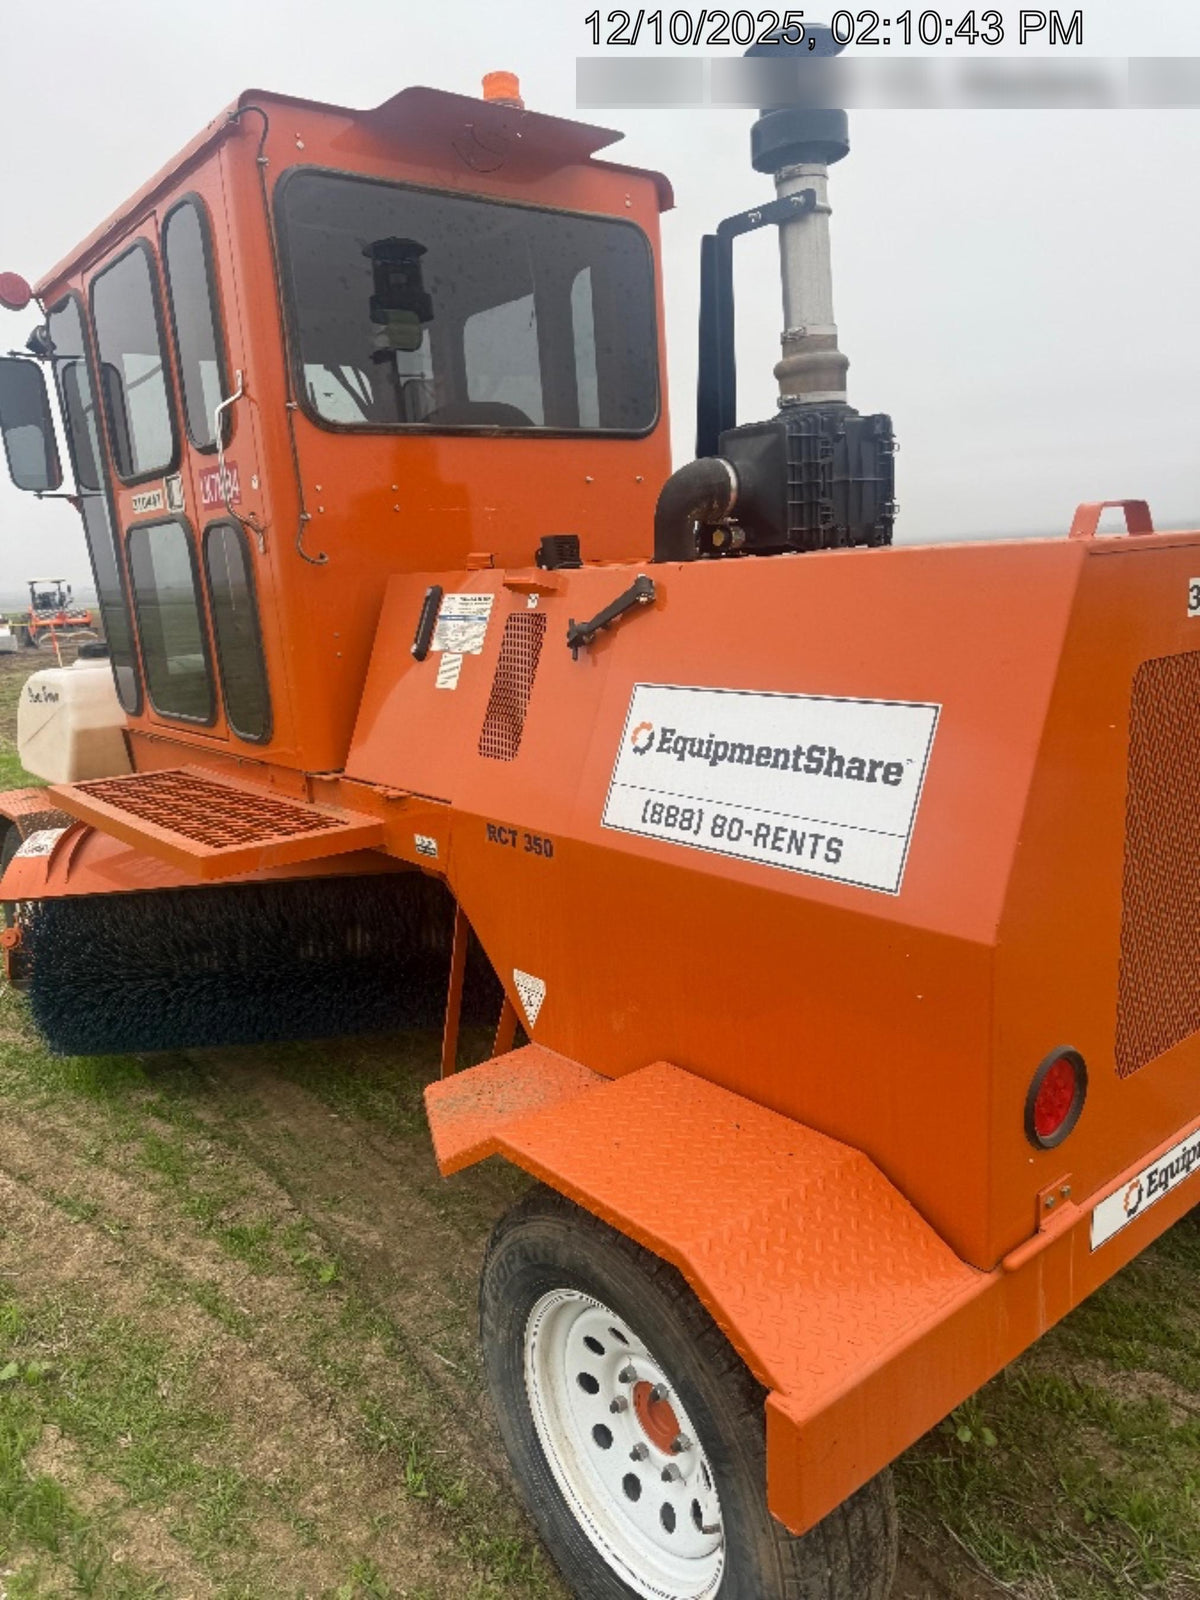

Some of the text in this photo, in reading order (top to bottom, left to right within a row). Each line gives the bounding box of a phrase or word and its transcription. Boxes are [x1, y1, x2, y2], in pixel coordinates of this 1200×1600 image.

[656, 727, 904, 786] EquipmentShare
[486, 823, 554, 858] RCT 350
[641, 799, 844, 864] (888) 80-RENTS
